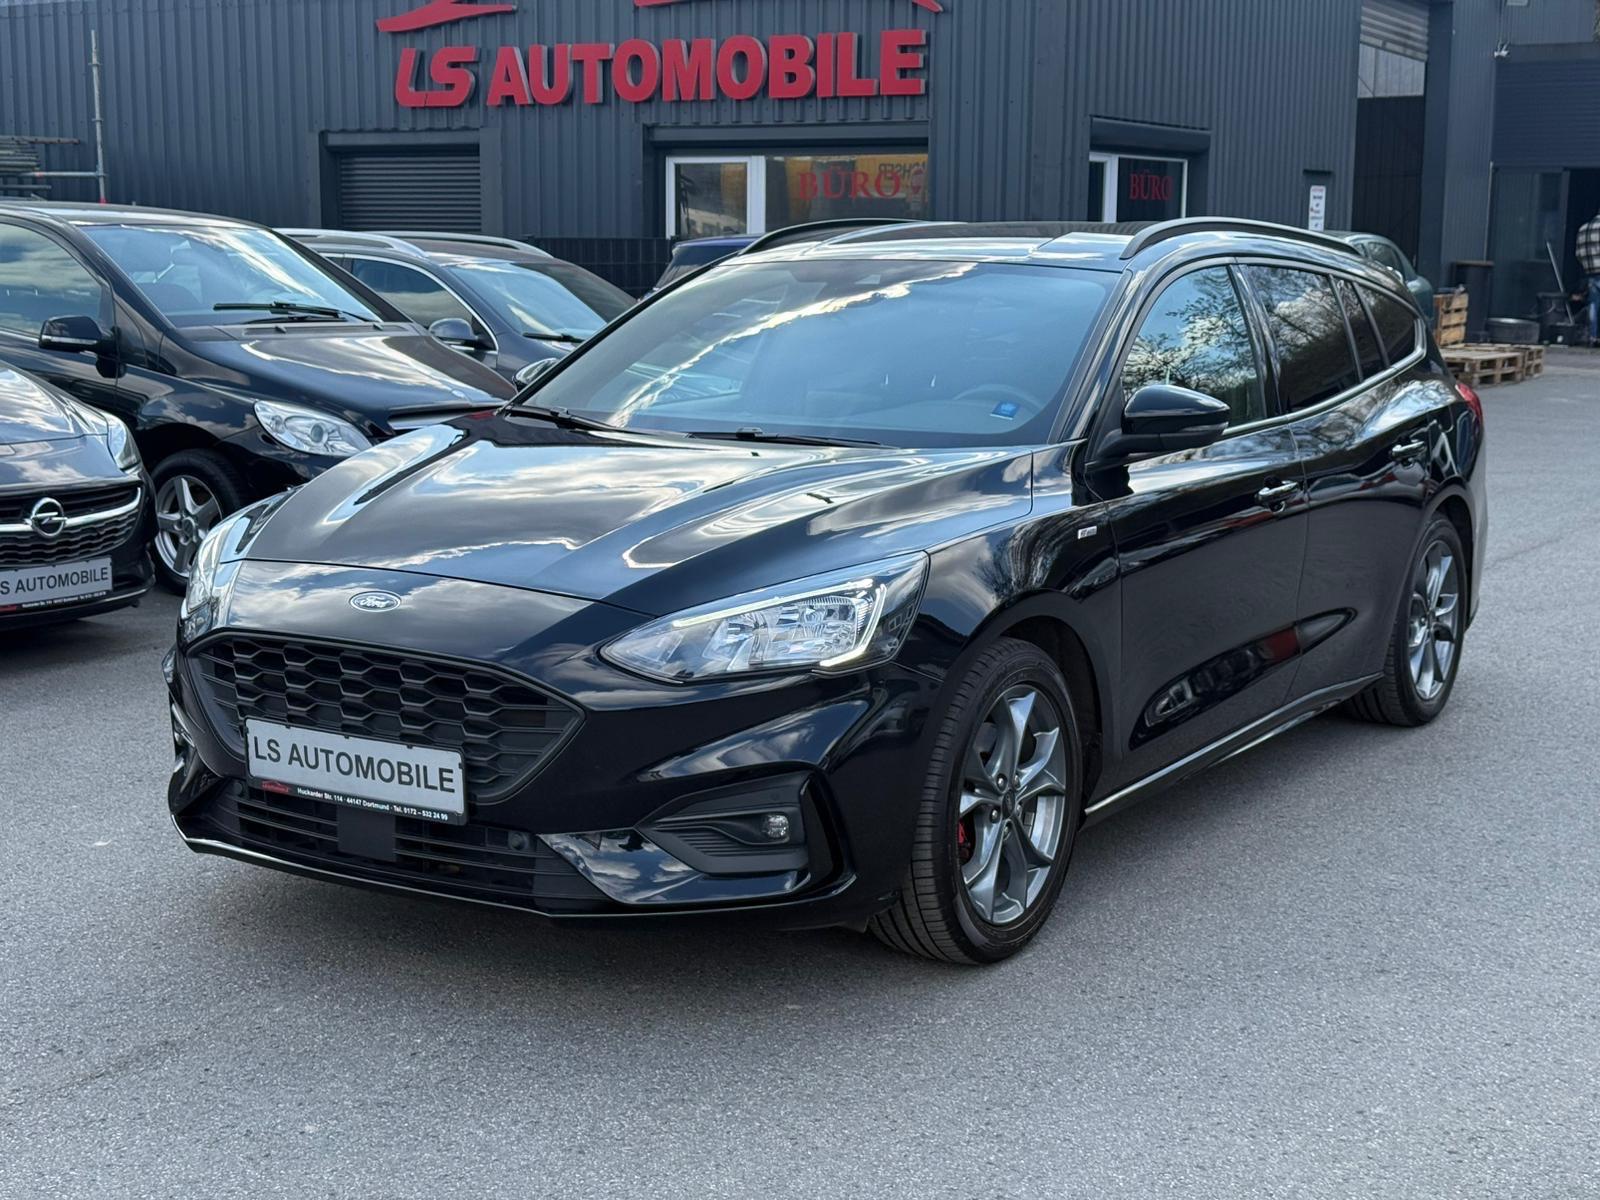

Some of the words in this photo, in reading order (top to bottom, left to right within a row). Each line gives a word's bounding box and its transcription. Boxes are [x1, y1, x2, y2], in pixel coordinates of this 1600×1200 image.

[395, 45, 478, 108] LS
[487, 29, 926, 106] AUTOMOBILE
[1129, 169, 1174, 200] BÜRO
[15, 567, 109, 594] AUTOMOBILE
[254, 736, 281, 763] LS
[288, 743, 455, 792] AUTOMOBILE
[362, 801, 389, 810] Dortmund
[393, 805, 402, 813] Tel.
